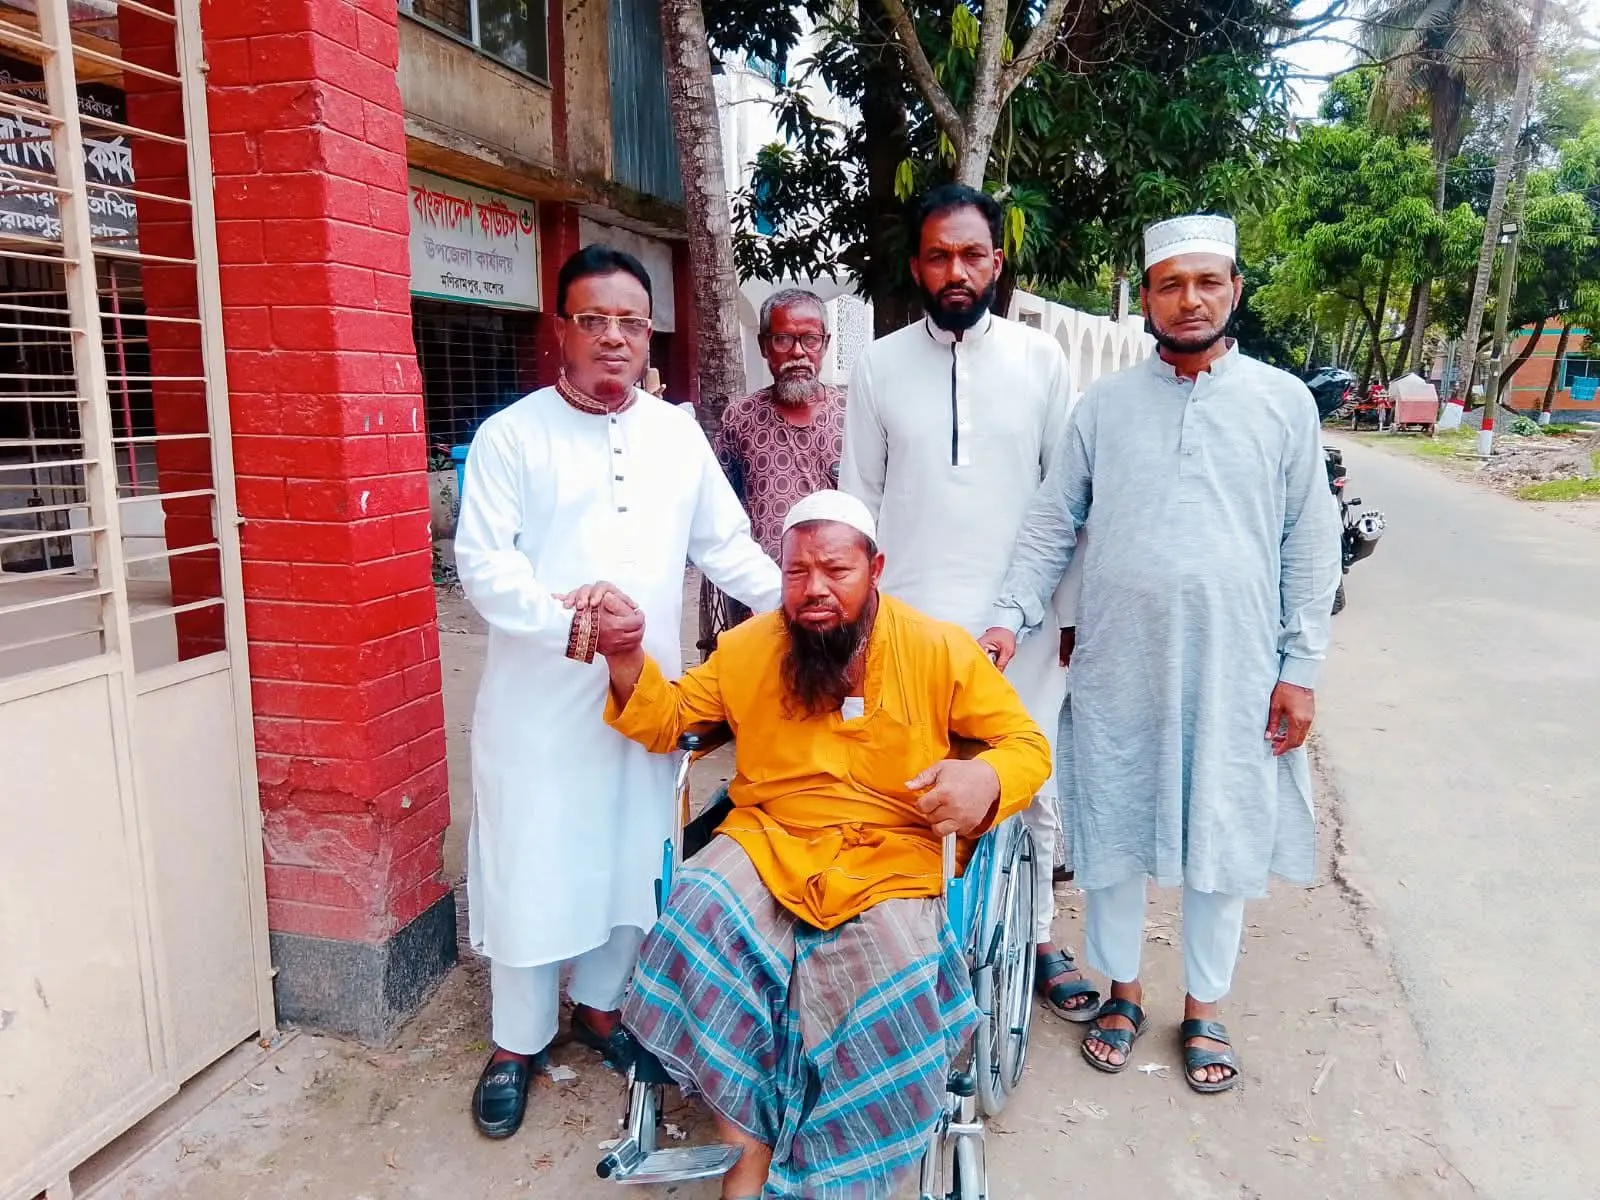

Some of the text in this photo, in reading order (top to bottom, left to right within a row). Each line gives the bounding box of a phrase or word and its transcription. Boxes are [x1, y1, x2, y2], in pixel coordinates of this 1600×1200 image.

[409, 183, 474, 238] বাংলাদেশ
[423, 235, 514, 274] উপজেলা কার্যালয়
[483, 281, 504, 295] যশোর
